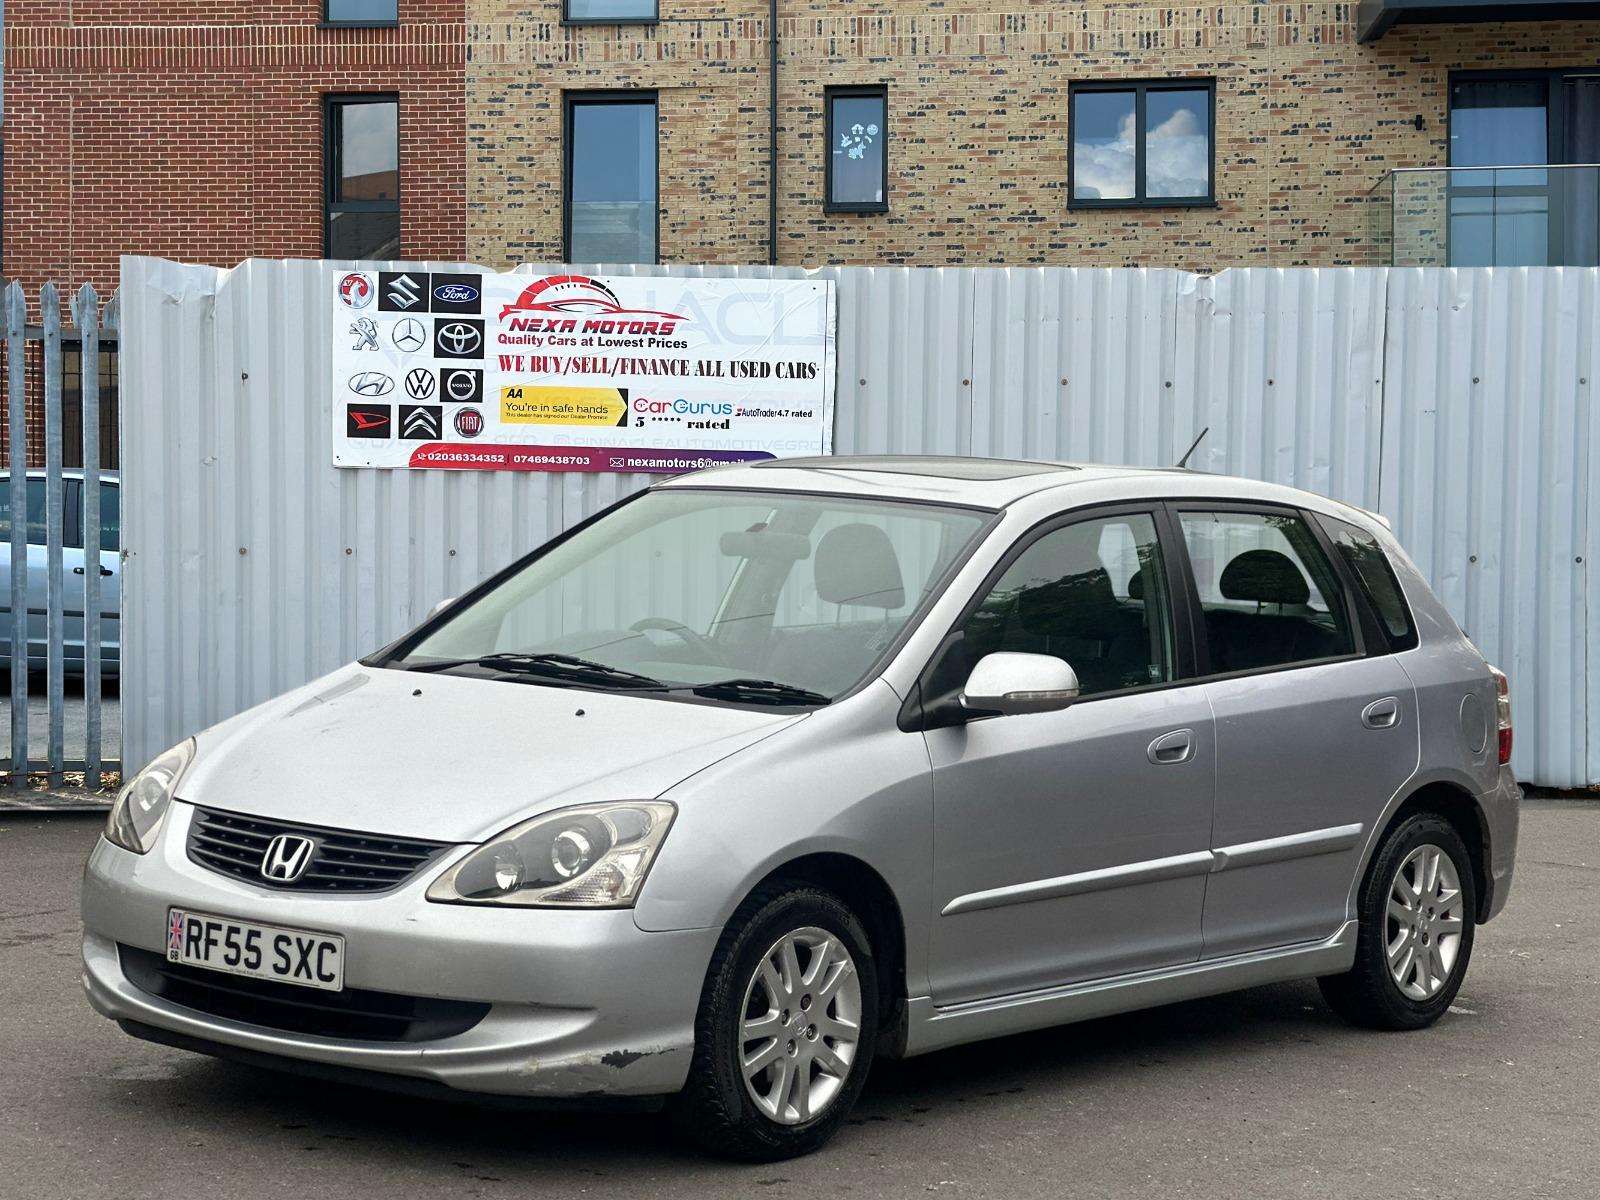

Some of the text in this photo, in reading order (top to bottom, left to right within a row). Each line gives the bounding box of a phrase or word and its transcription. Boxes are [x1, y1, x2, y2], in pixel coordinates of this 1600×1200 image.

[442, 286, 470, 299] Ford
[508, 318, 677, 336] NEXA MOTORS
[497, 333, 688, 349] Quality Cars at Lowest Prices
[498, 354, 817, 380] WE BUY/SELL/FINANCE ALL USED CARS
[506, 388, 523, 399] AA
[505, 402, 609, 414] You're in safe hands
[633, 398, 733, 415] CarGurus
[791, 410, 813, 418] rated
[461, 416, 479, 430] FIAT
[635, 416, 730, 430] 5 rated
[427, 453, 505, 463] 02036334352
[513, 455, 590, 465] 07469438703
[169, 950, 179, 961] GB
[184, 917, 338, 983] RF55 SXC
